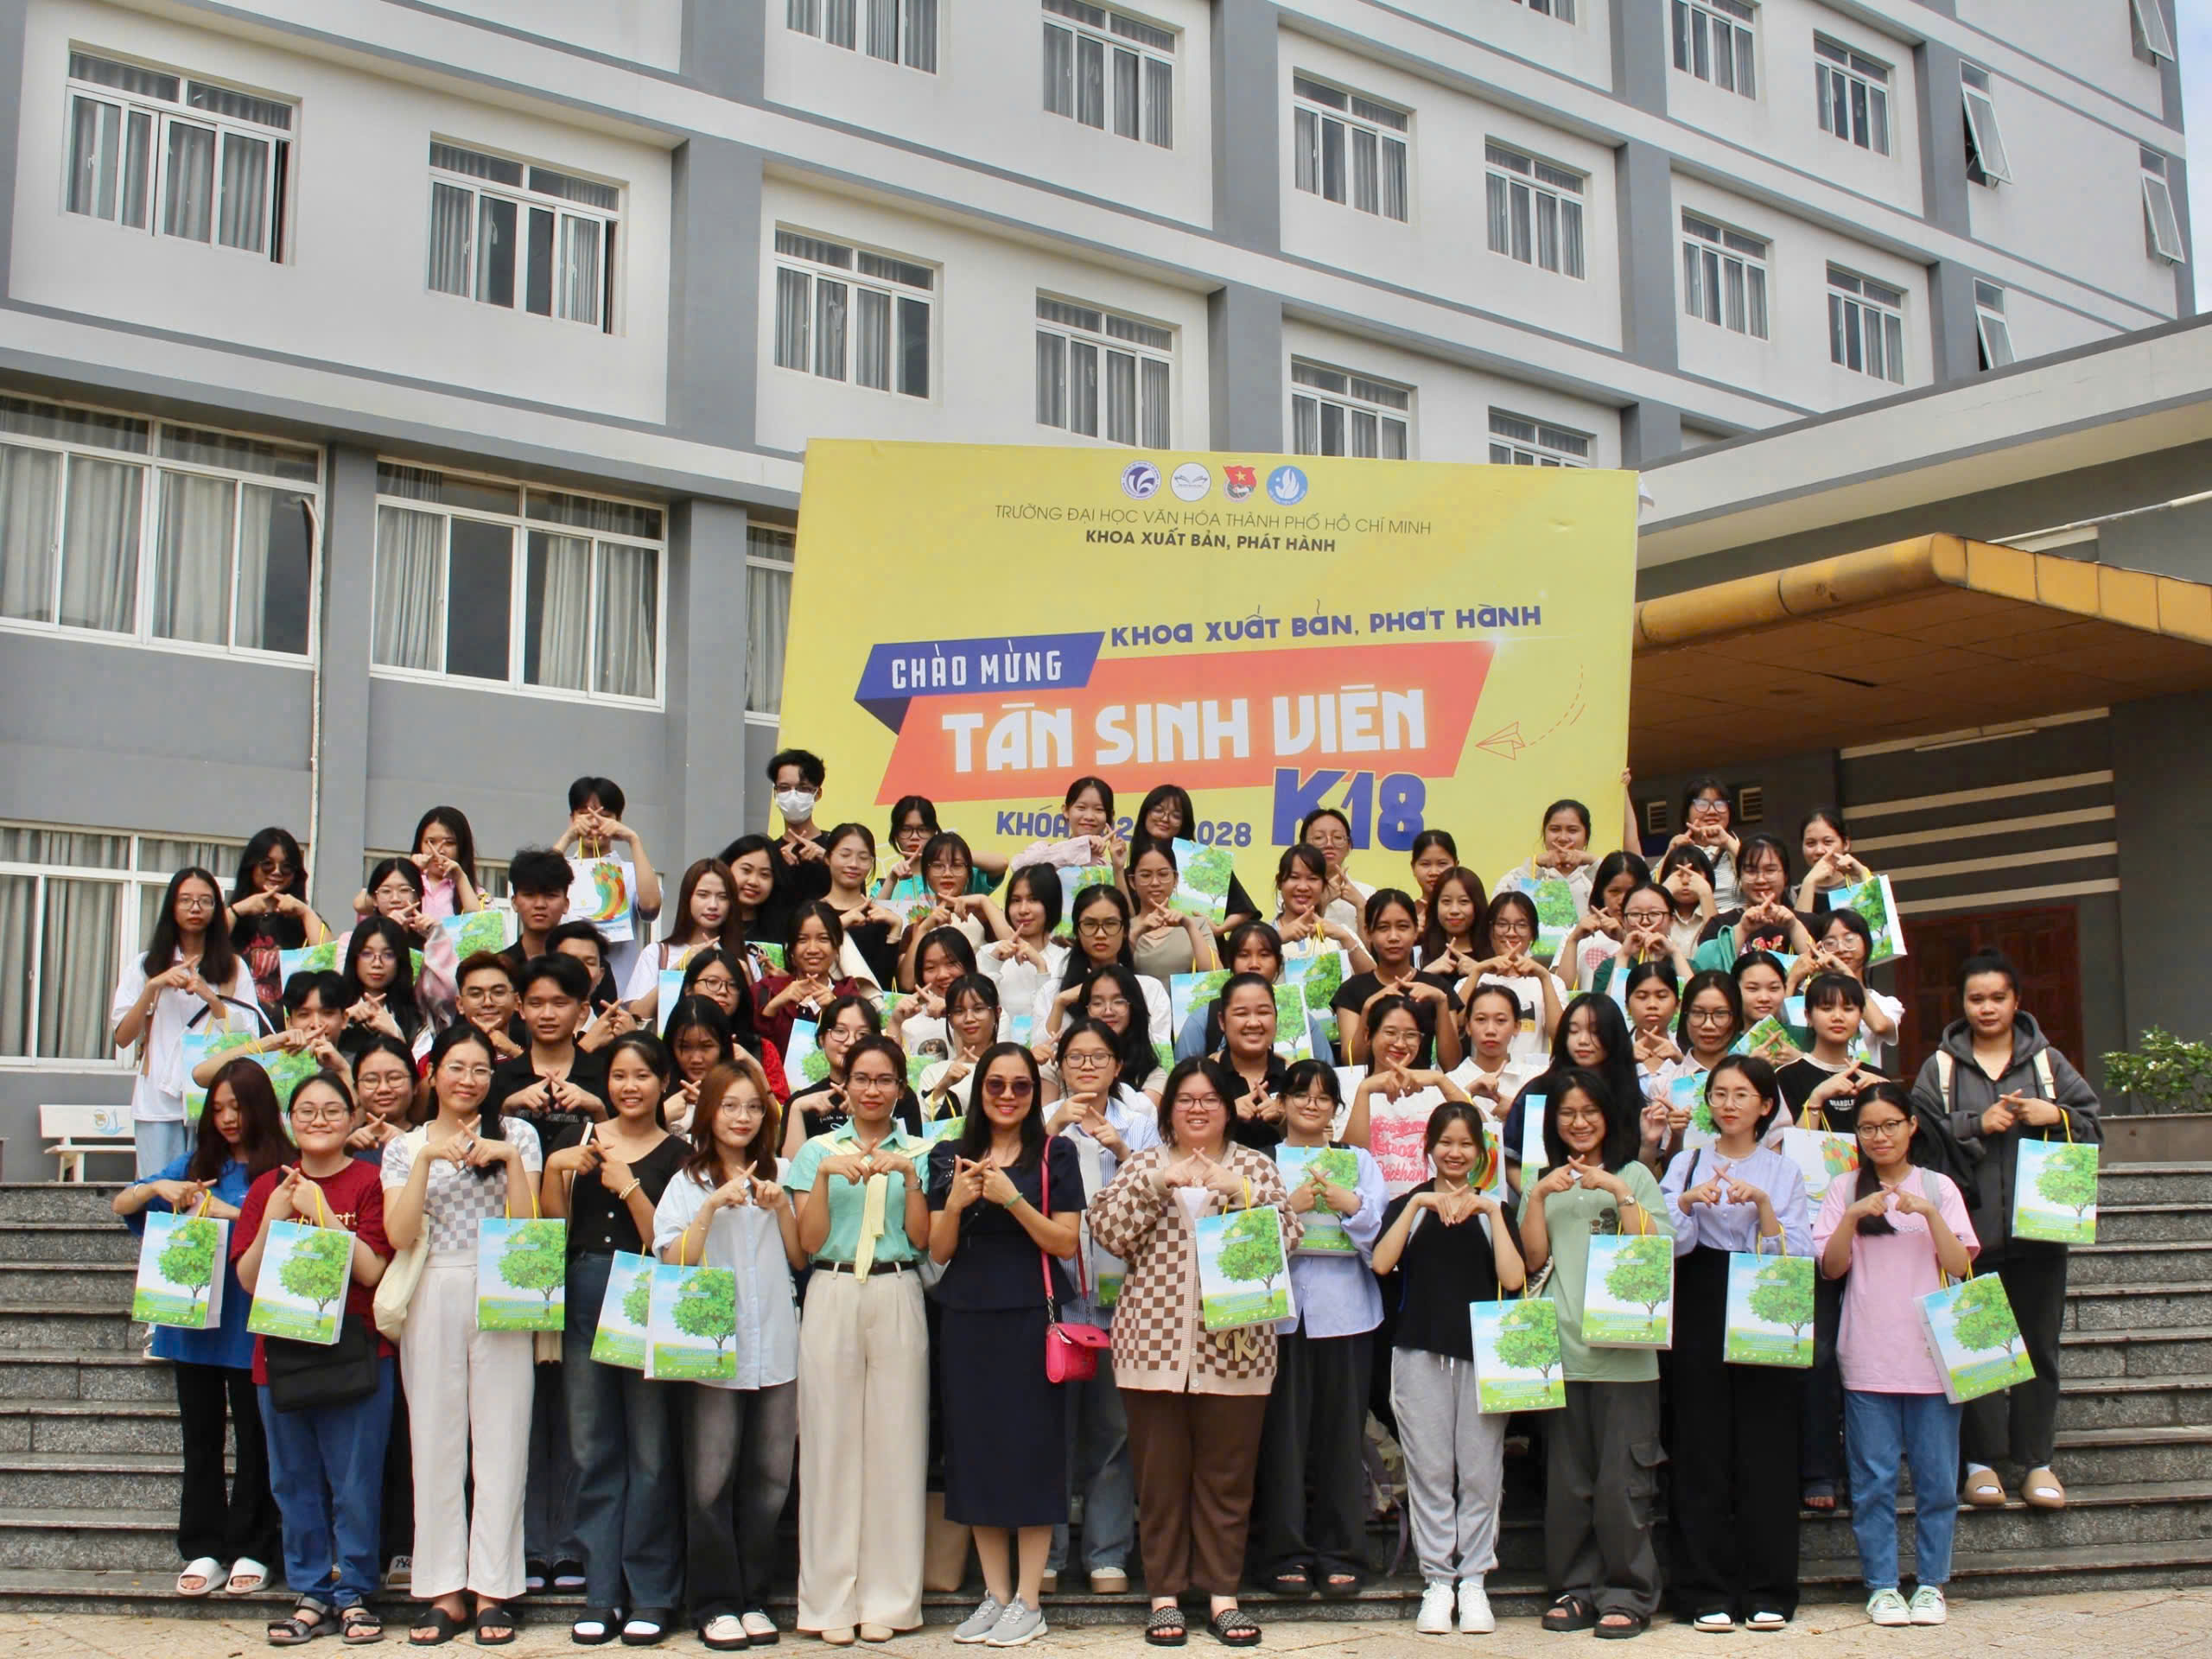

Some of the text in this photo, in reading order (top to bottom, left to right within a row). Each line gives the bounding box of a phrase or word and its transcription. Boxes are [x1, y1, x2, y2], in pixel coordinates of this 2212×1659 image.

[995, 503, 1431, 535] TRƯỜNG ĐẠI HỌC VĂN HÓA THÀNH PHỐ HỒ CHÍ MINH
[1086, 527, 1336, 552] KHOA XUẤT BẢN, PHÁT HÀNH
[892, 639, 1062, 690] CHÀO MỪNG
[1095, 697, 1250, 766] SINH
[995, 804, 1070, 838] KHÓA
[1271, 768, 1427, 852] K18
